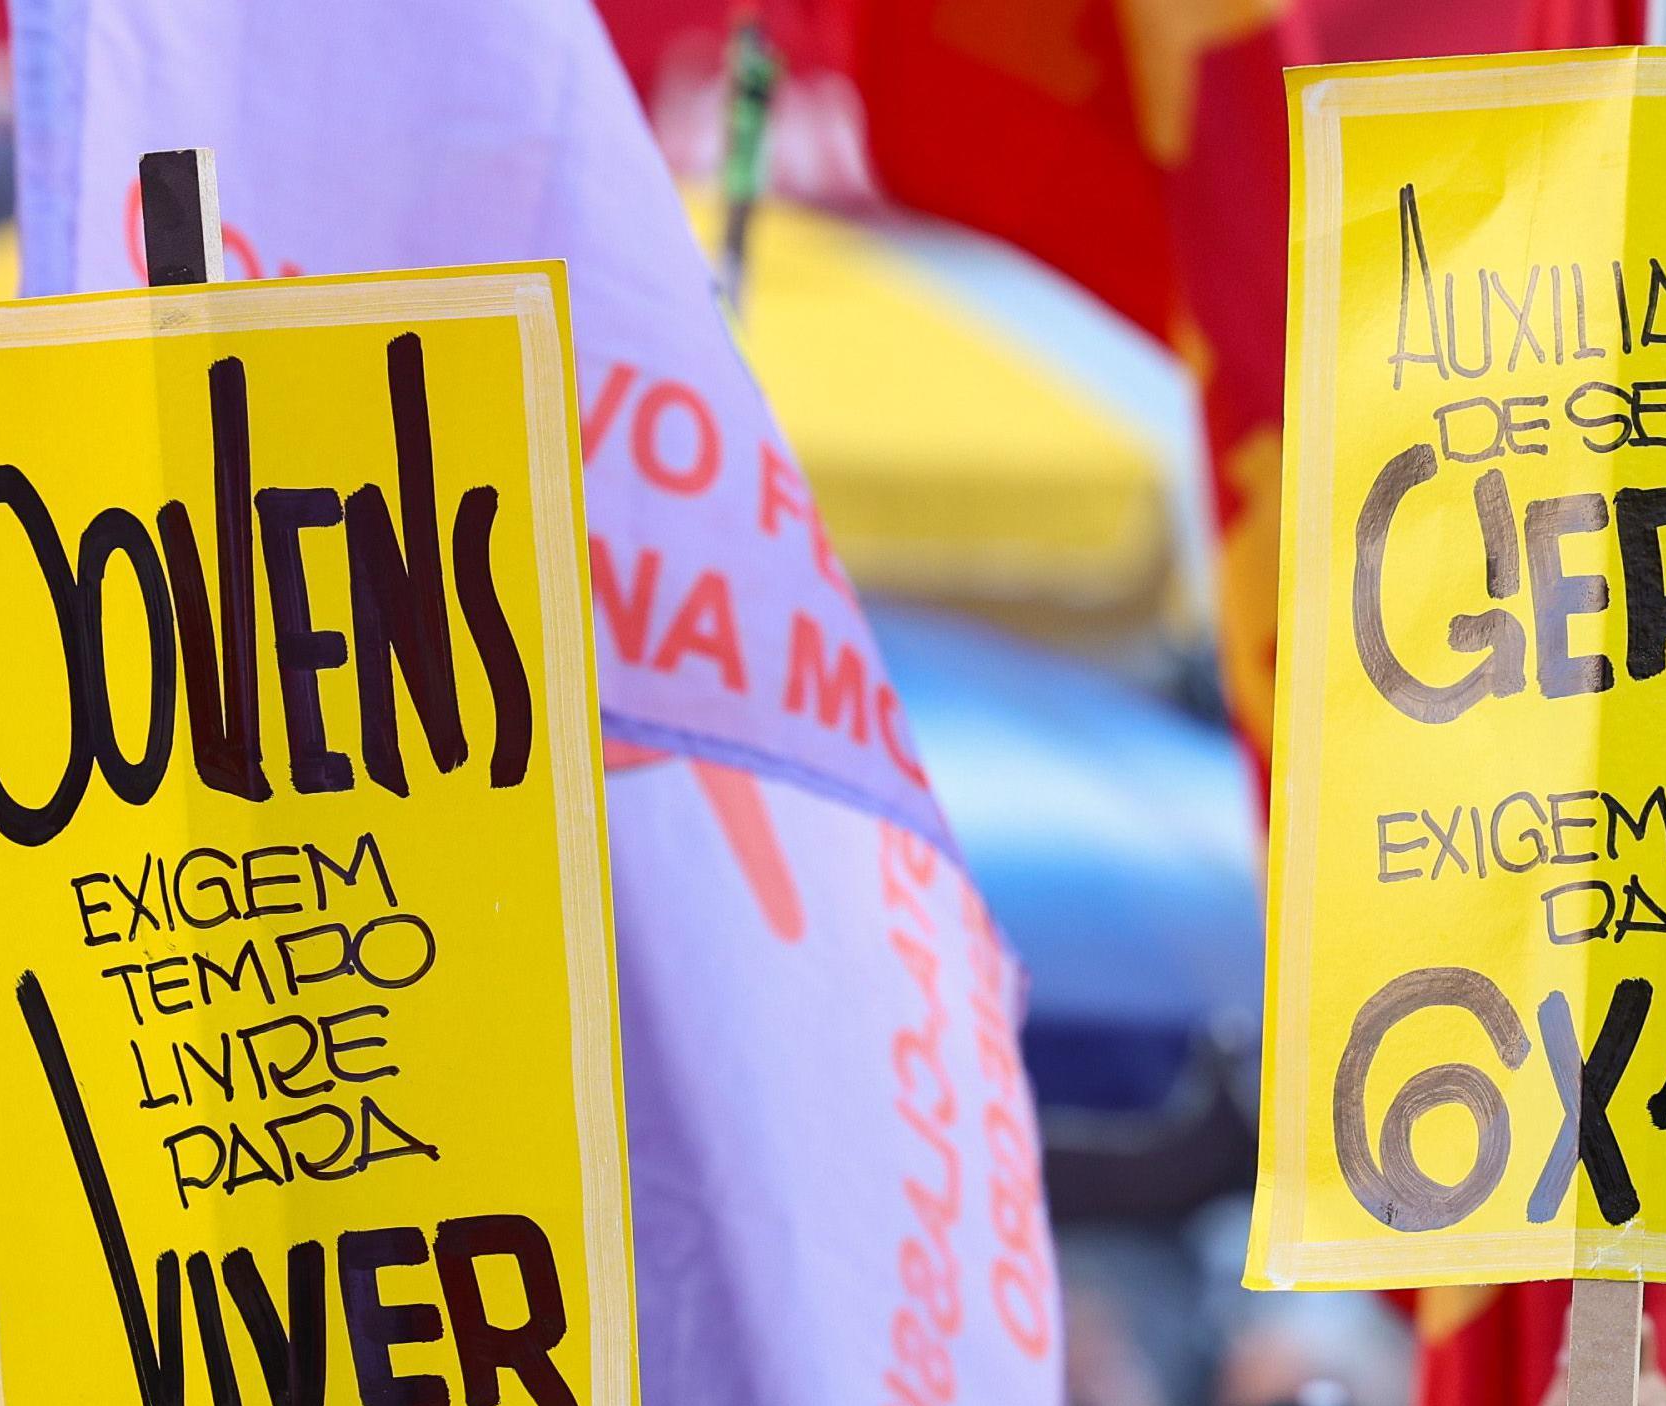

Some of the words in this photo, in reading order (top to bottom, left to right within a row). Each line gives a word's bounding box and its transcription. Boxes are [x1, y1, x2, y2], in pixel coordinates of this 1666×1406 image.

[1433, 394, 1549, 463] DE
[71, 833, 399, 946] EXIGEM
[101, 914, 437, 1024] TEMPO
[131, 1005, 400, 1109] LIVRE
[163, 1096, 440, 1209] PARA
